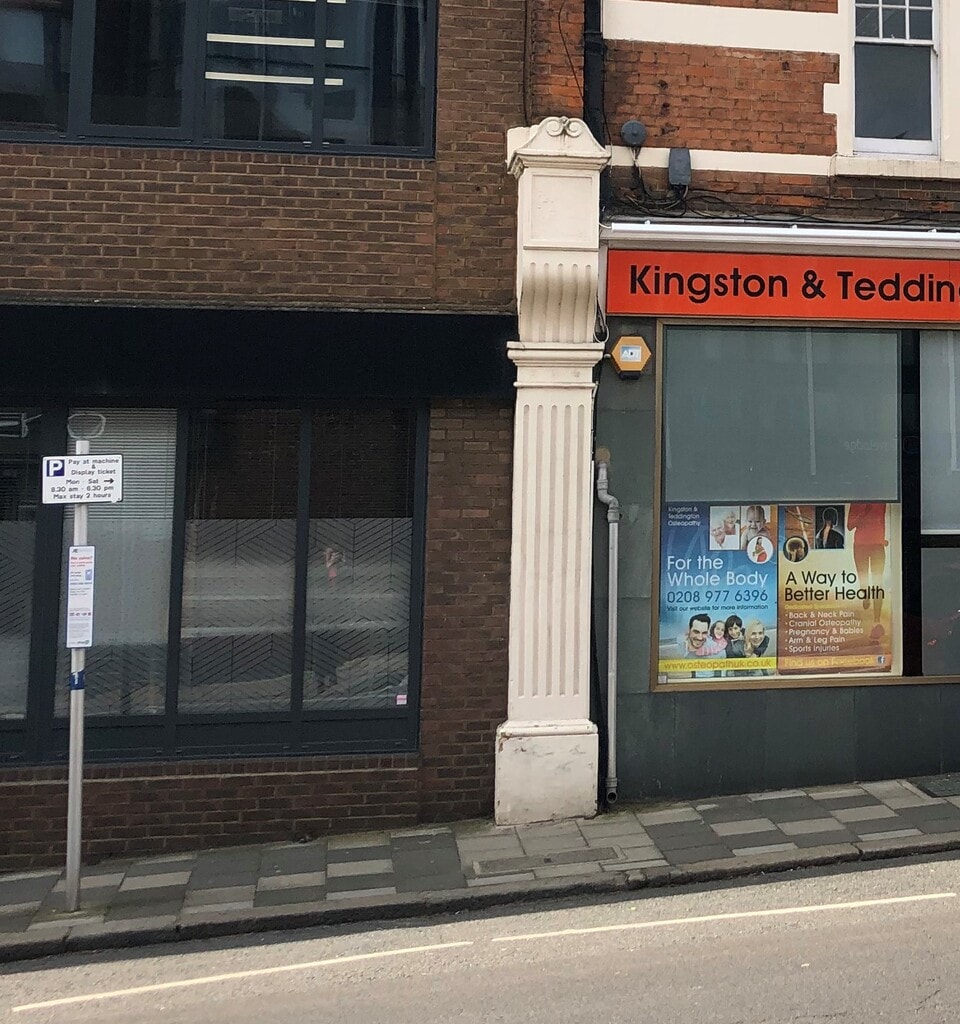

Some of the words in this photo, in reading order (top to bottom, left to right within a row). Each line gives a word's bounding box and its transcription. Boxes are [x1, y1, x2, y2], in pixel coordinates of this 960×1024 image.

[629, 265, 788, 304] Kingston
[801, 269, 826, 299] &
[49, 460, 63, 476] P
[667, 555, 691, 570] For
[697, 555, 723, 569] the
[667, 571, 720, 586] Whole
[726, 571, 768, 588] Body
[785, 571, 797, 585] A
[801, 570, 837, 587] Way
[841, 570, 857, 584] to
[667, 590, 700, 603] 0208
[705, 590, 730, 602] 977
[734, 589, 768, 601] 6396
[785, 587, 830, 601] Better
[835, 585, 885, 600] Health
[788, 611, 808, 619] Back
[818, 619, 861, 627] Osteopathy
[788, 628, 830, 636] Pregnancy
[813, 636, 828, 644] Leg
[788, 645, 811, 653] Sports
[813, 644, 840, 652] Injuries
